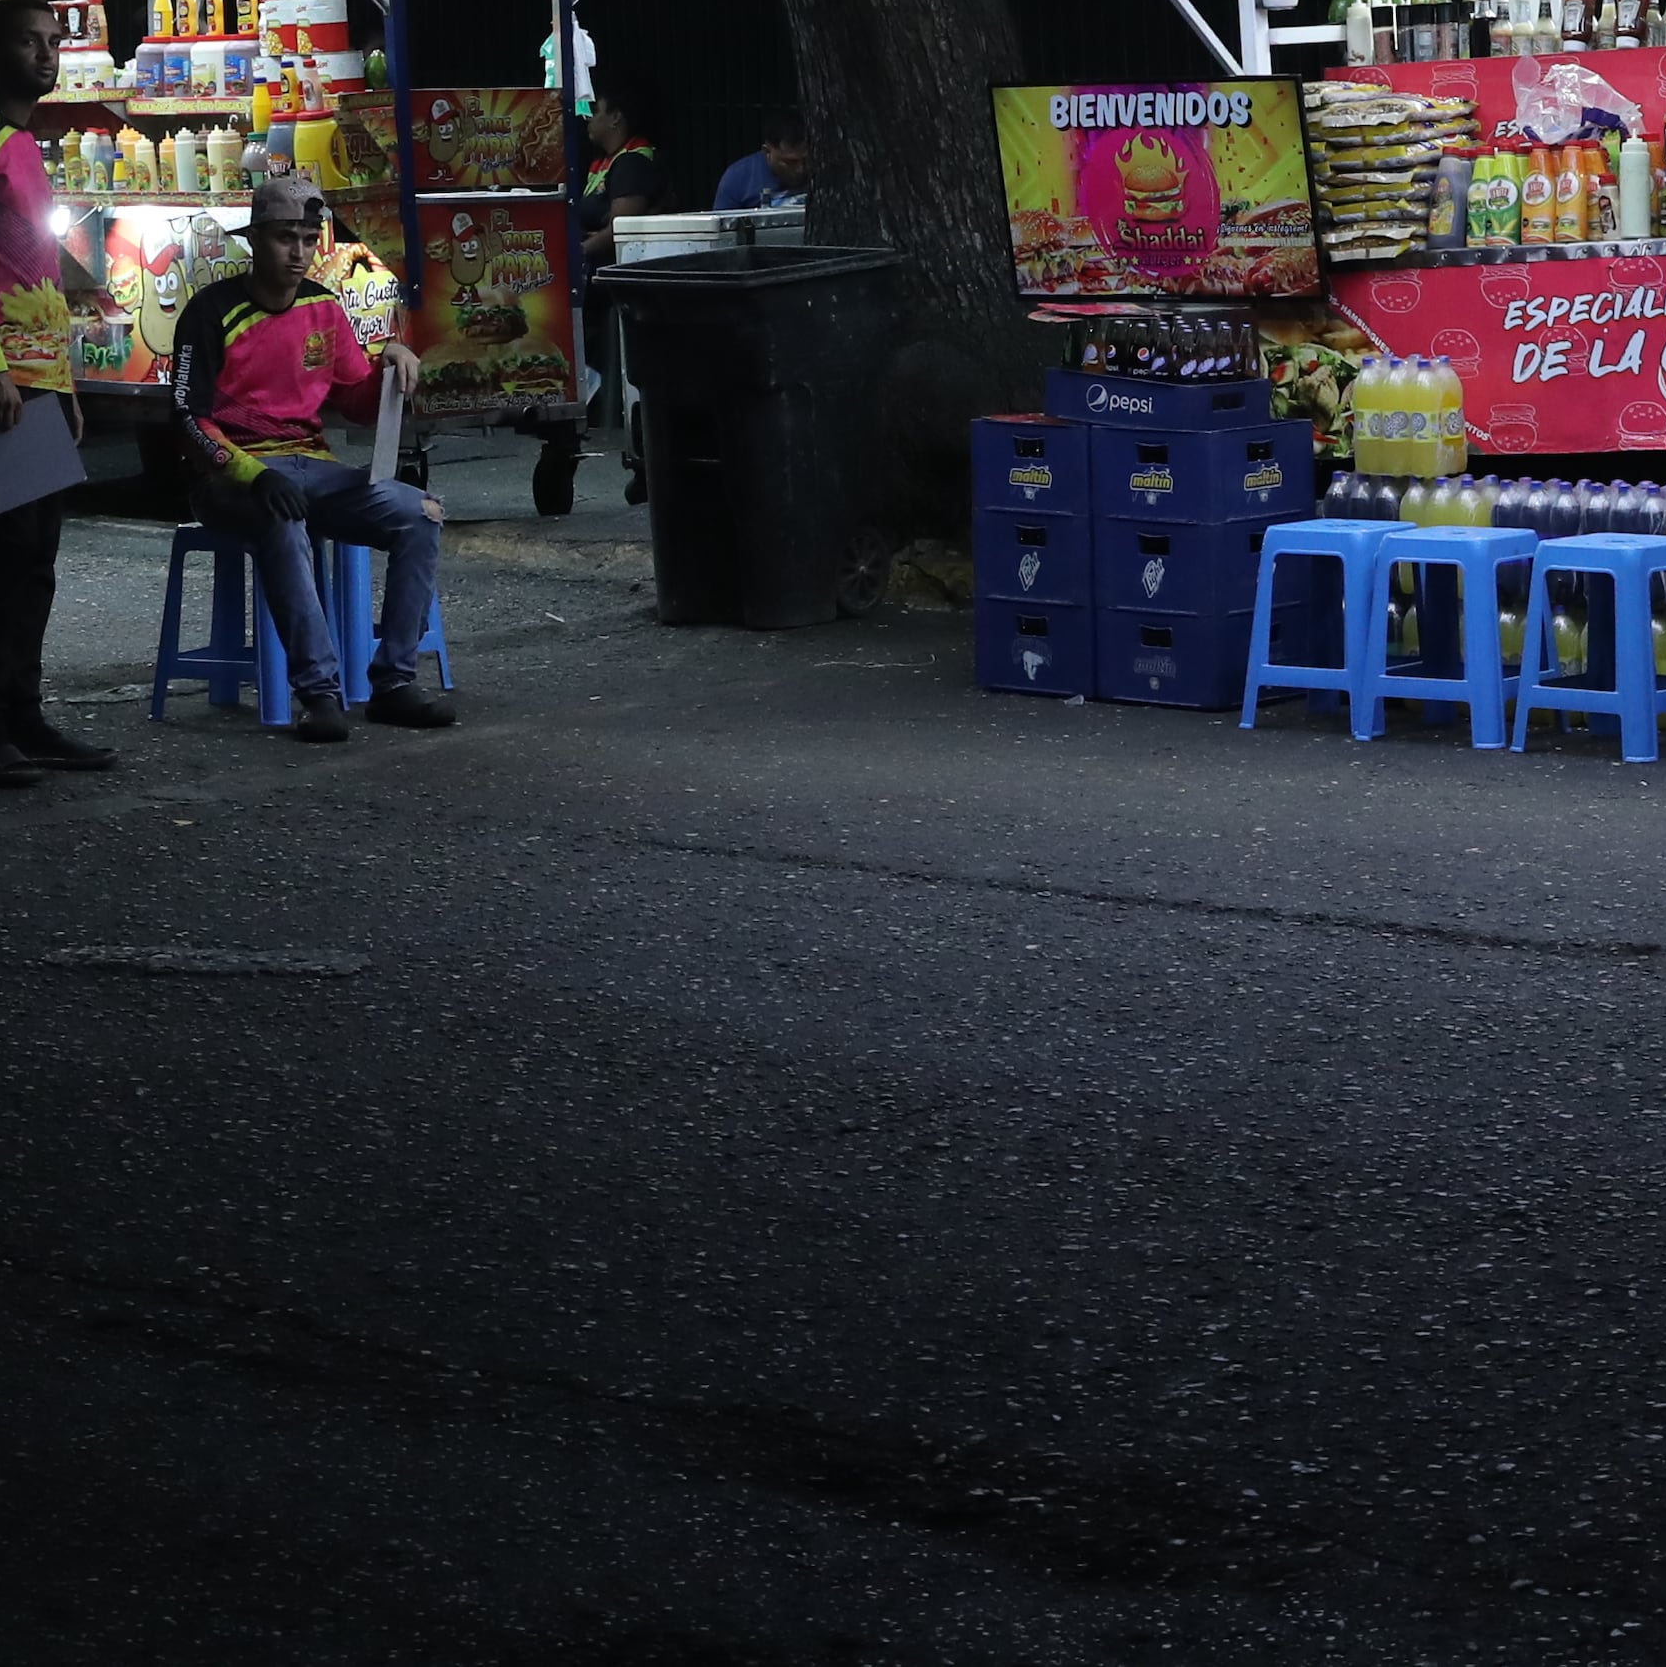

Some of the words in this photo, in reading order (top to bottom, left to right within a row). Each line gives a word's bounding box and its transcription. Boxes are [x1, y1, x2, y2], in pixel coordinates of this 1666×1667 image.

[1049, 91, 1253, 129] BIENVENIDOS
[1116, 225, 1208, 251] Shaddai
[1512, 340, 1576, 384] DE
[1588, 335, 1643, 375] LA
[1108, 392, 1154, 415] pepsi
[1009, 467, 1052, 489] maltin
[1130, 471, 1173, 494] maltin
[1244, 467, 1282, 491] maltin
